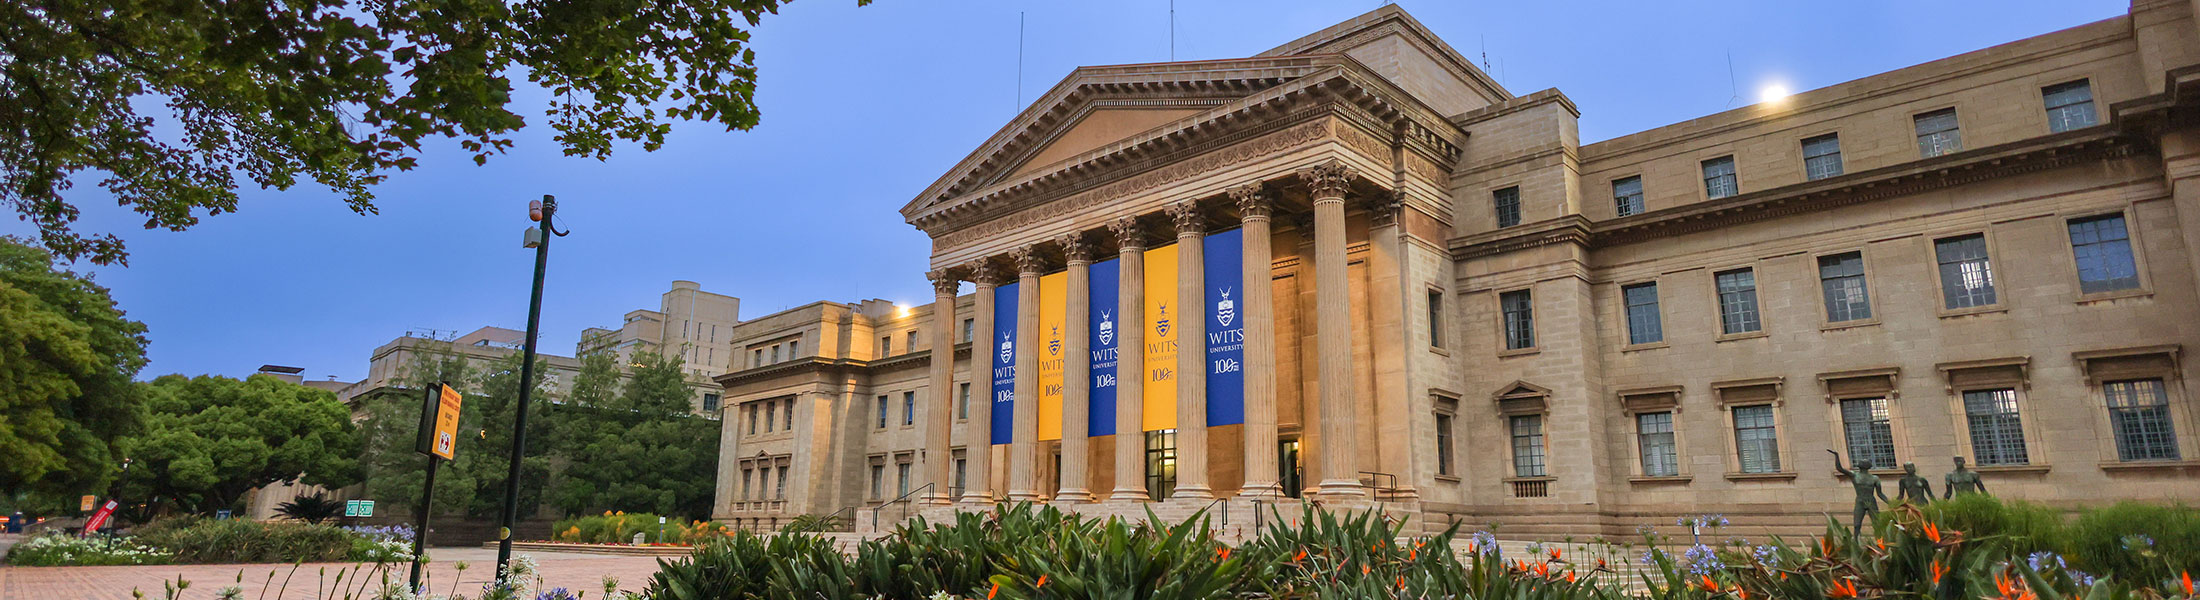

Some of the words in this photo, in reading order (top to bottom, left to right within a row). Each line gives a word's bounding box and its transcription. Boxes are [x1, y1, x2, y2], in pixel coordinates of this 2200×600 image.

[1209, 328, 1244, 345] WITS
[1148, 340, 1178, 354] WITS
[1209, 343, 1244, 354] UNIVERSITY
[1214, 358, 1236, 374] 100
[1096, 373, 1113, 388] 100
[1152, 367, 1171, 382] 100
